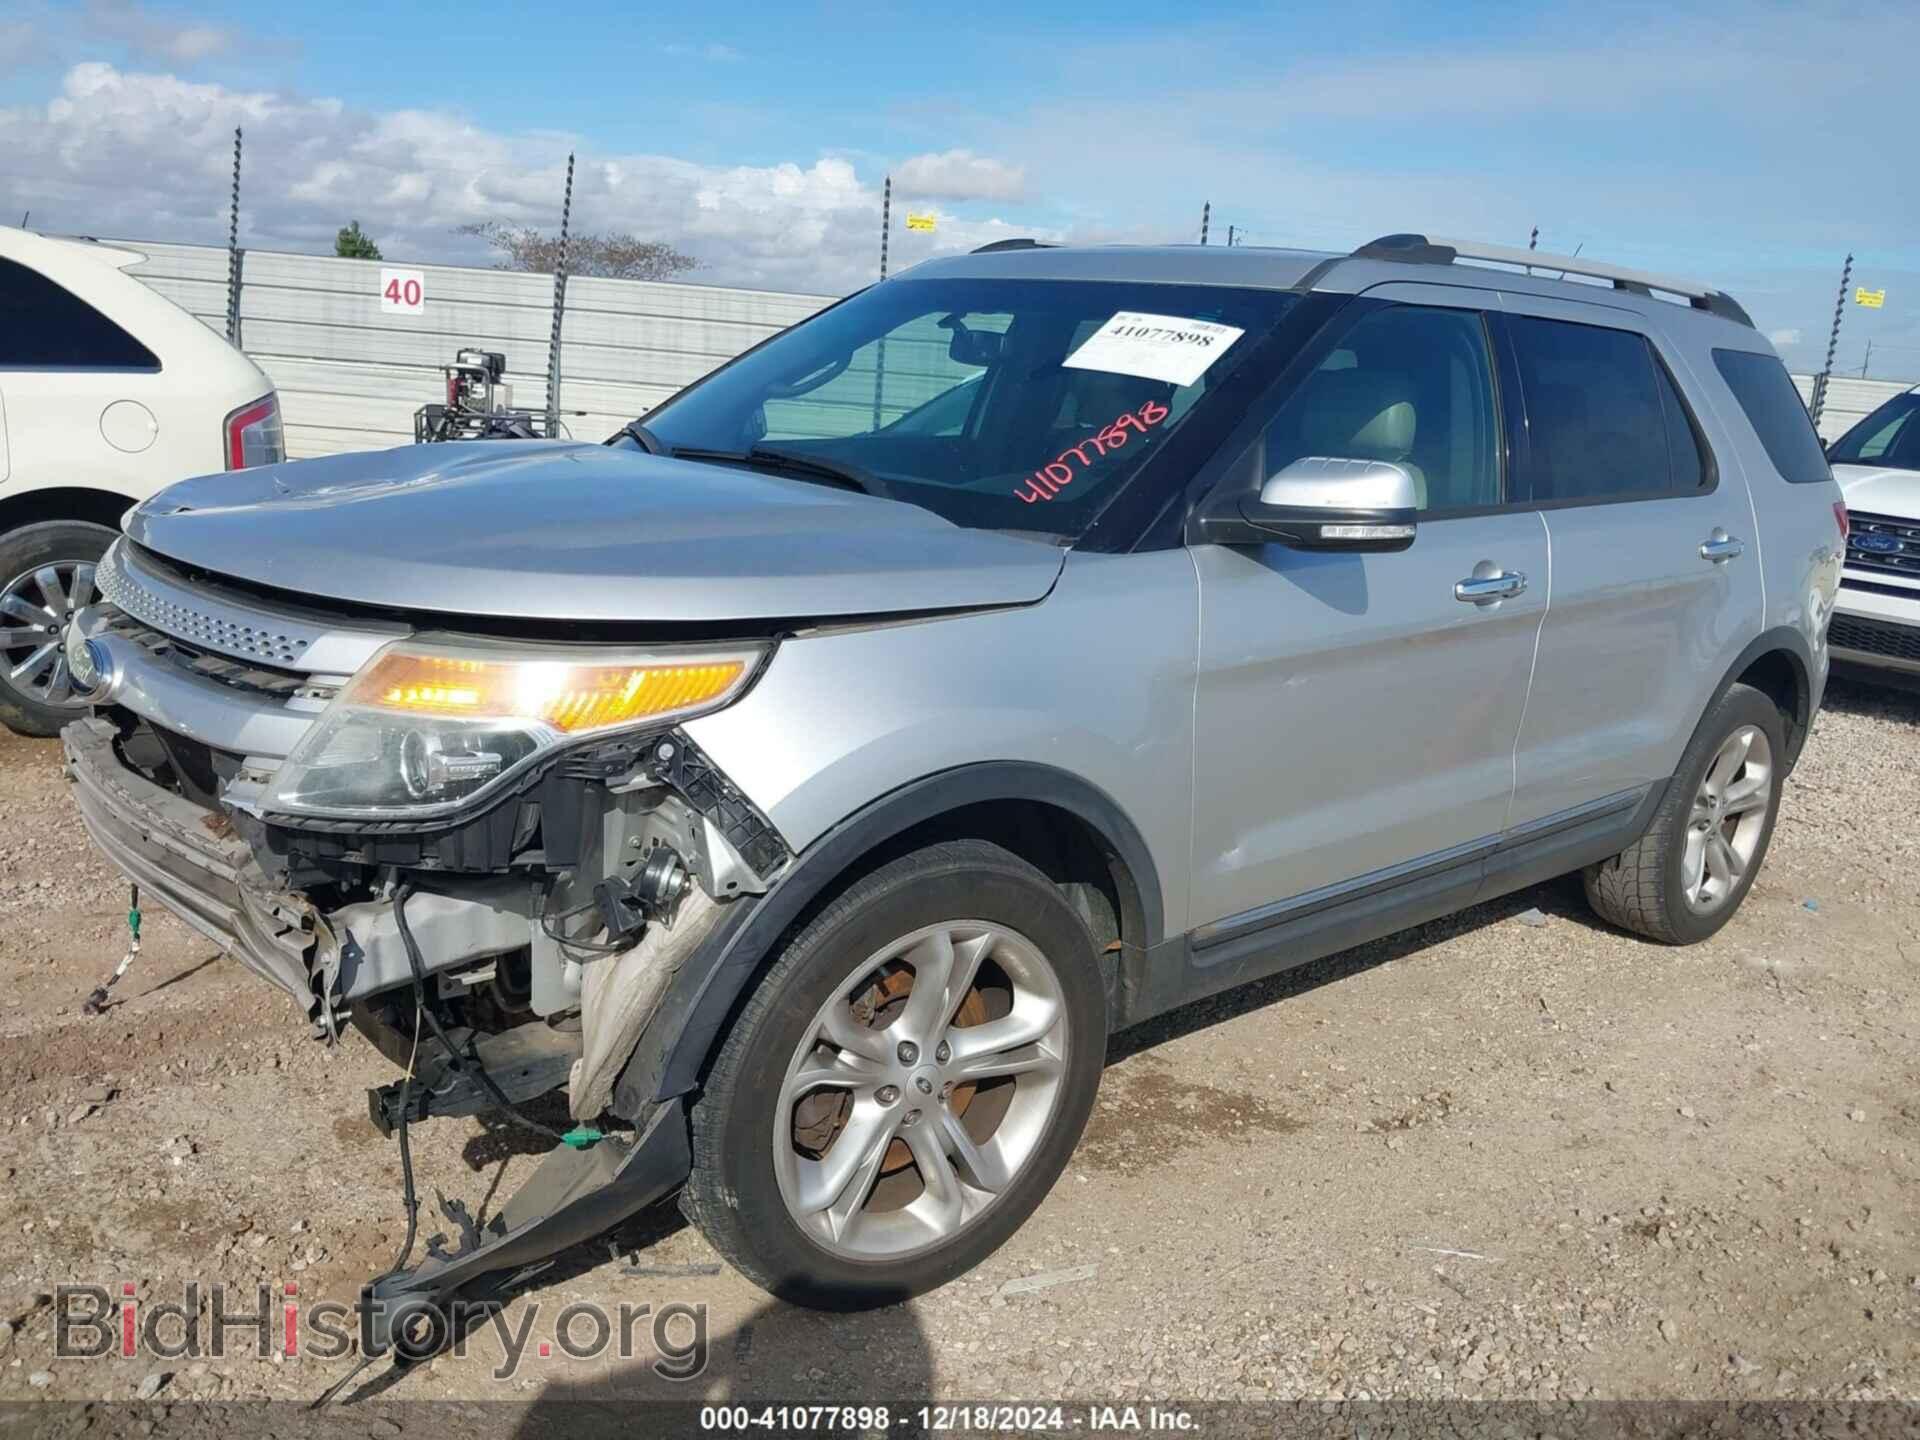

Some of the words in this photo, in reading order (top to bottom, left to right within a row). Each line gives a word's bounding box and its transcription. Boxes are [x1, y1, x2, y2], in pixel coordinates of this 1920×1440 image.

[383, 278, 421, 306] 40
[1110, 324, 1216, 349] 41077898
[1012, 399, 1170, 504] 41077898
